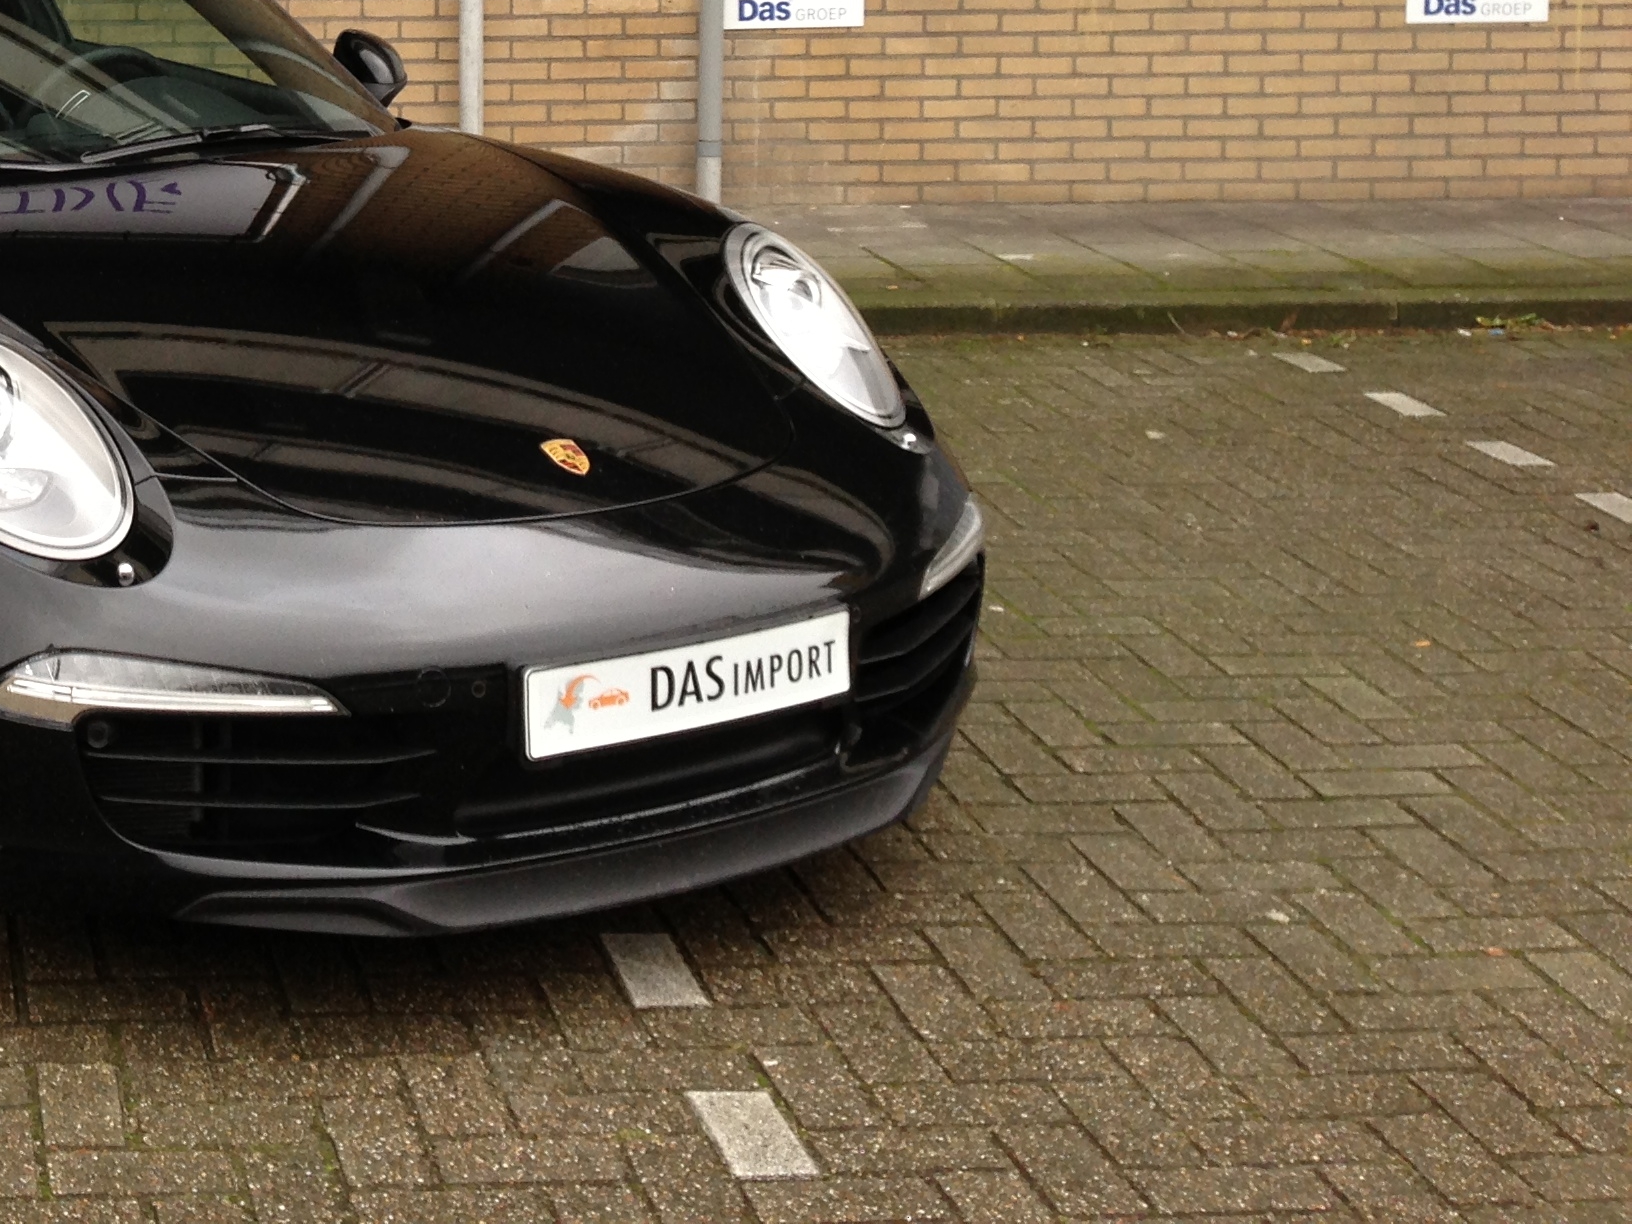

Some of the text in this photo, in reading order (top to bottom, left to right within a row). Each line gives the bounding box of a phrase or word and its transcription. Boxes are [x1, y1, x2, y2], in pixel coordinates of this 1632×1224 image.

[795, 7, 847, 22] GROEP
[1480, 2, 1532, 17] GROEP
[650, 639, 836, 712] DAS IMPORT
